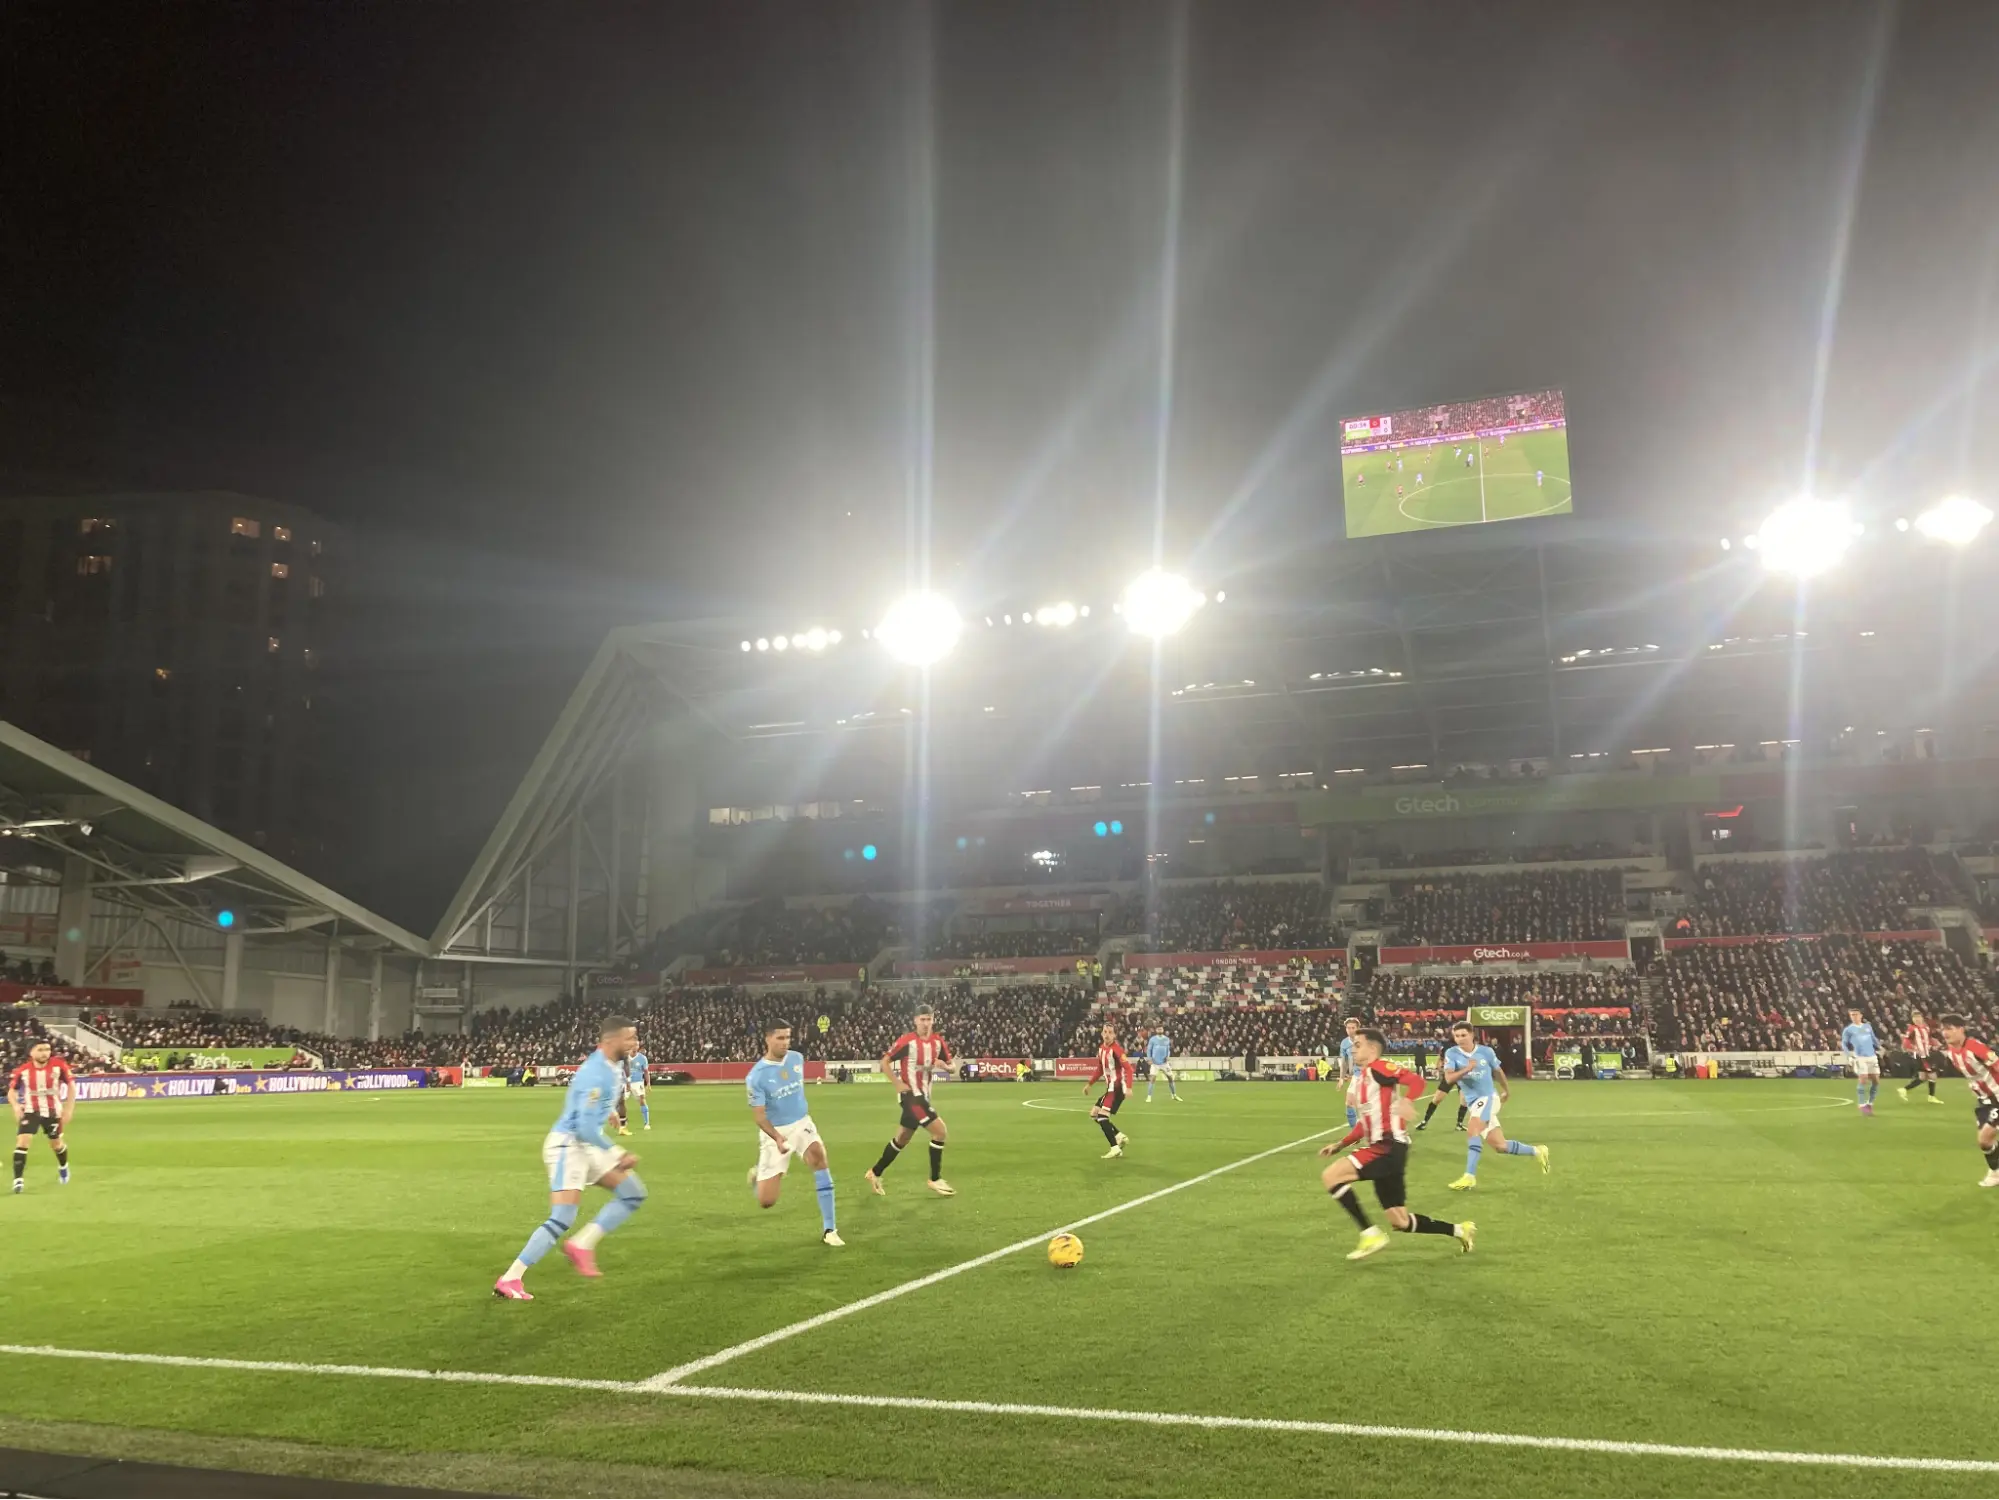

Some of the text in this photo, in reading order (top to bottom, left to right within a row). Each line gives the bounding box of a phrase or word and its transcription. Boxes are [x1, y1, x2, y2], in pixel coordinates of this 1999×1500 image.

[1395, 795, 1459, 813] Gtech
[597, 975, 624, 985] Gtech
[1480, 1008, 1520, 1021] Gtech
[269, 1076, 328, 1091] HOLLYWOOD
[357, 1074, 408, 1088] HOLLYWOOD
[1990, 1108, 1998, 1119] 6
[51, 1123, 59, 1132] 7
